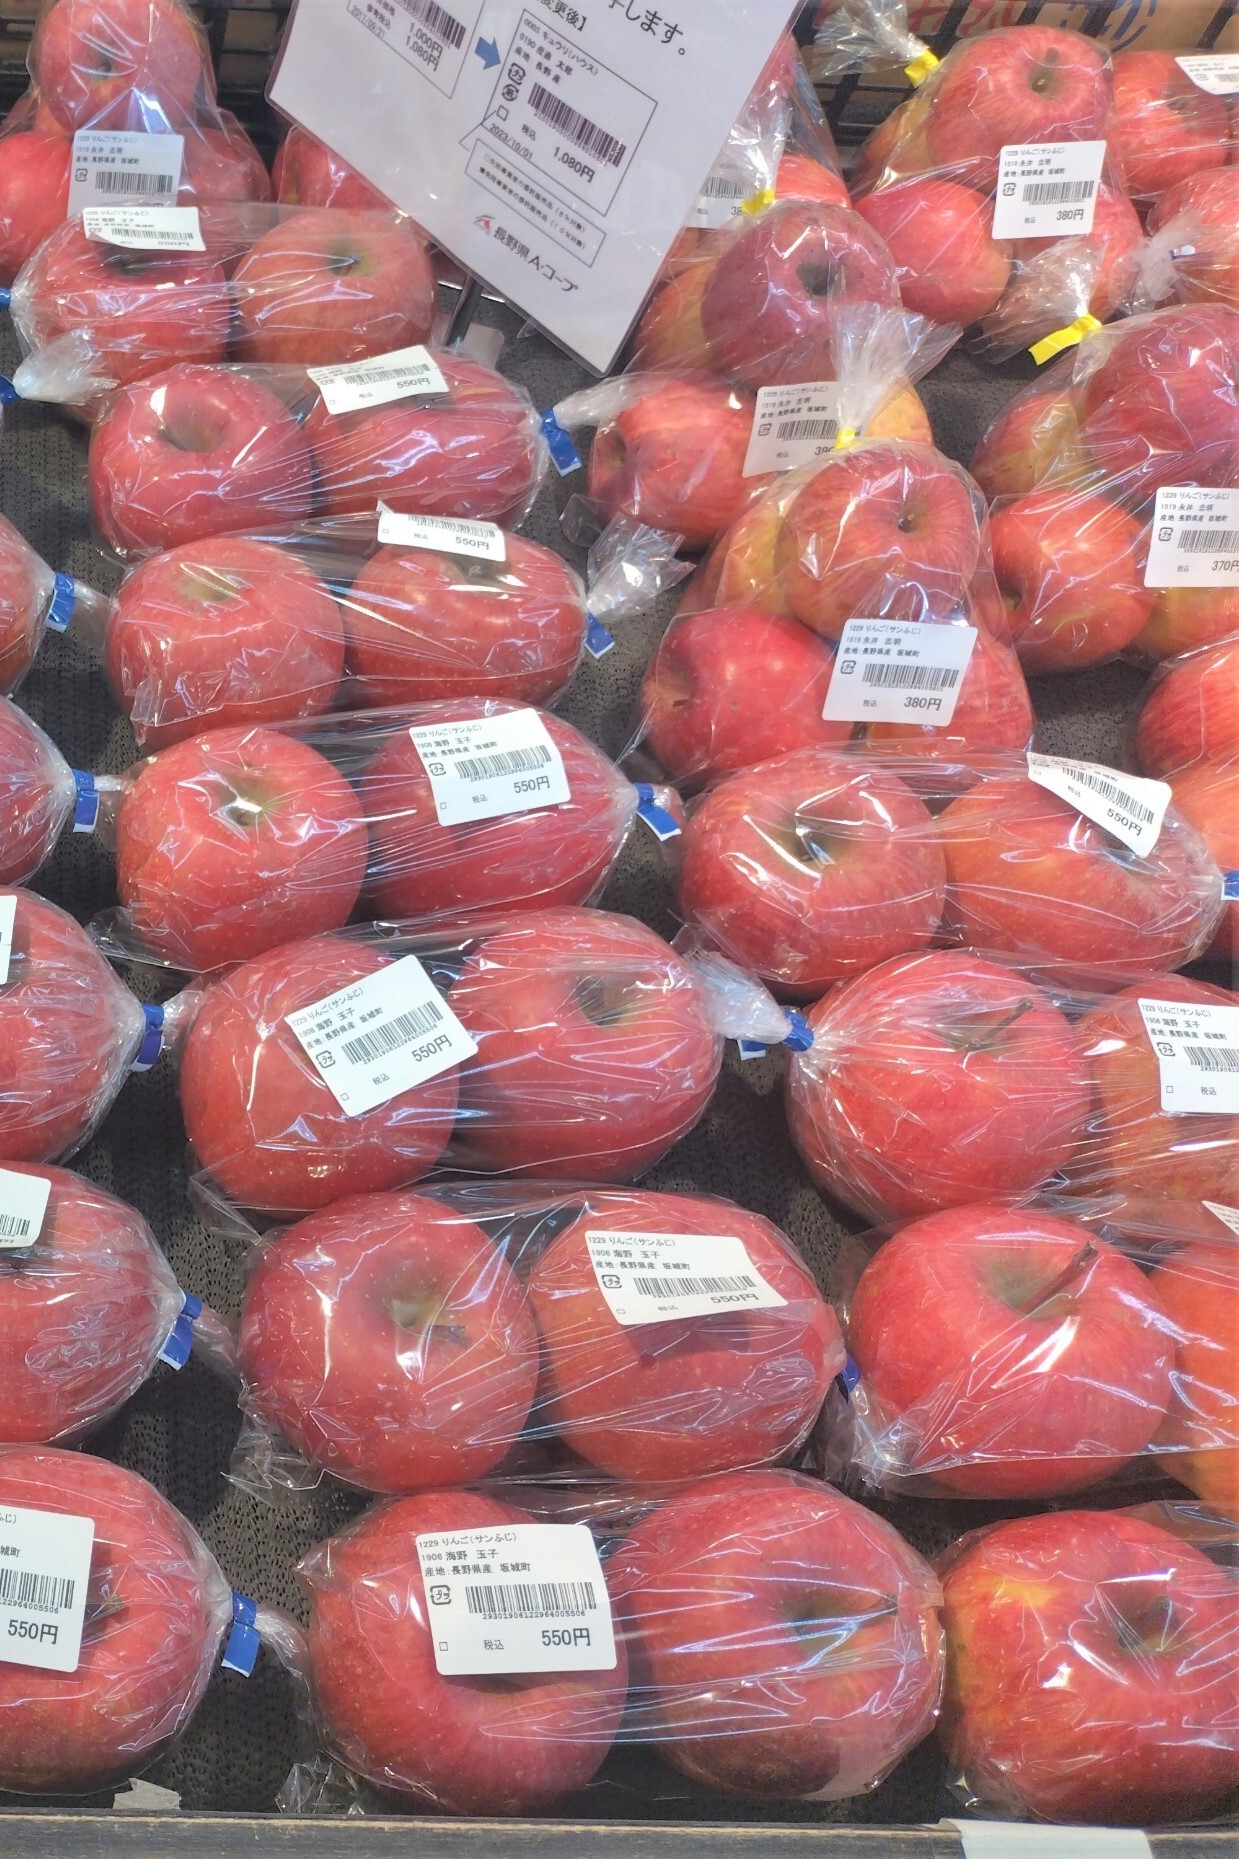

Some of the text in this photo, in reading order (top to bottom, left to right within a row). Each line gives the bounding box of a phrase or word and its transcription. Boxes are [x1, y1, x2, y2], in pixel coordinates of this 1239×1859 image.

[555, 60, 573, 76] 太郎
[489, 122, 533, 160] 2023/10/01
[553, 146, 596, 184] 1,080円
[1019, 158, 1034, 167] 永井
[1024, 208, 1085, 224] 税込 380円
[396, 377, 431, 389] 550円
[776, 450, 789, 459] 税込
[1177, 502, 1194, 512] 永井
[1198, 503, 1214, 513] 忠明
[1176, 564, 1190, 573] 税込
[849, 623, 864, 632] 1229
[862, 636, 902, 647] 永井 忠明
[862, 696, 943, 712] 税込 380円
[411, 730, 428, 739] 1229
[455, 736, 472, 745] 玉子
[471, 775, 551, 804] 税込 550円
[1106, 807, 1143, 837] 550円
[291, 987, 364, 1027] 1229 りんご(サンふじ)
[1141, 1004, 1156, 1013] 1229
[315, 1017, 333, 1032] 海野
[336, 1007, 355, 1022] 玉子
[1183, 1020, 1201, 1029] 玉子
[371, 1034, 453, 1086] 税込 550円
[1200, 1086, 1217, 1096] 税込
[587, 1235, 676, 1247] 1229 りんご(サンふじ)
[591, 1248, 661, 1259] 1906 海野 玉子
[657, 1293, 760, 1312] 税込 550円
[418, 1532, 517, 1549] 1229 りんご(サンふじ)
[421, 1548, 499, 1562] 1906 海野 玉子
[424, 1561, 531, 1577] 産地:長野県産 坂城町
[482, 1609, 586, 1620] 29301906122964005506
[7, 1619, 59, 1645] 550円
[483, 1627, 591, 1651] 税込 550円
